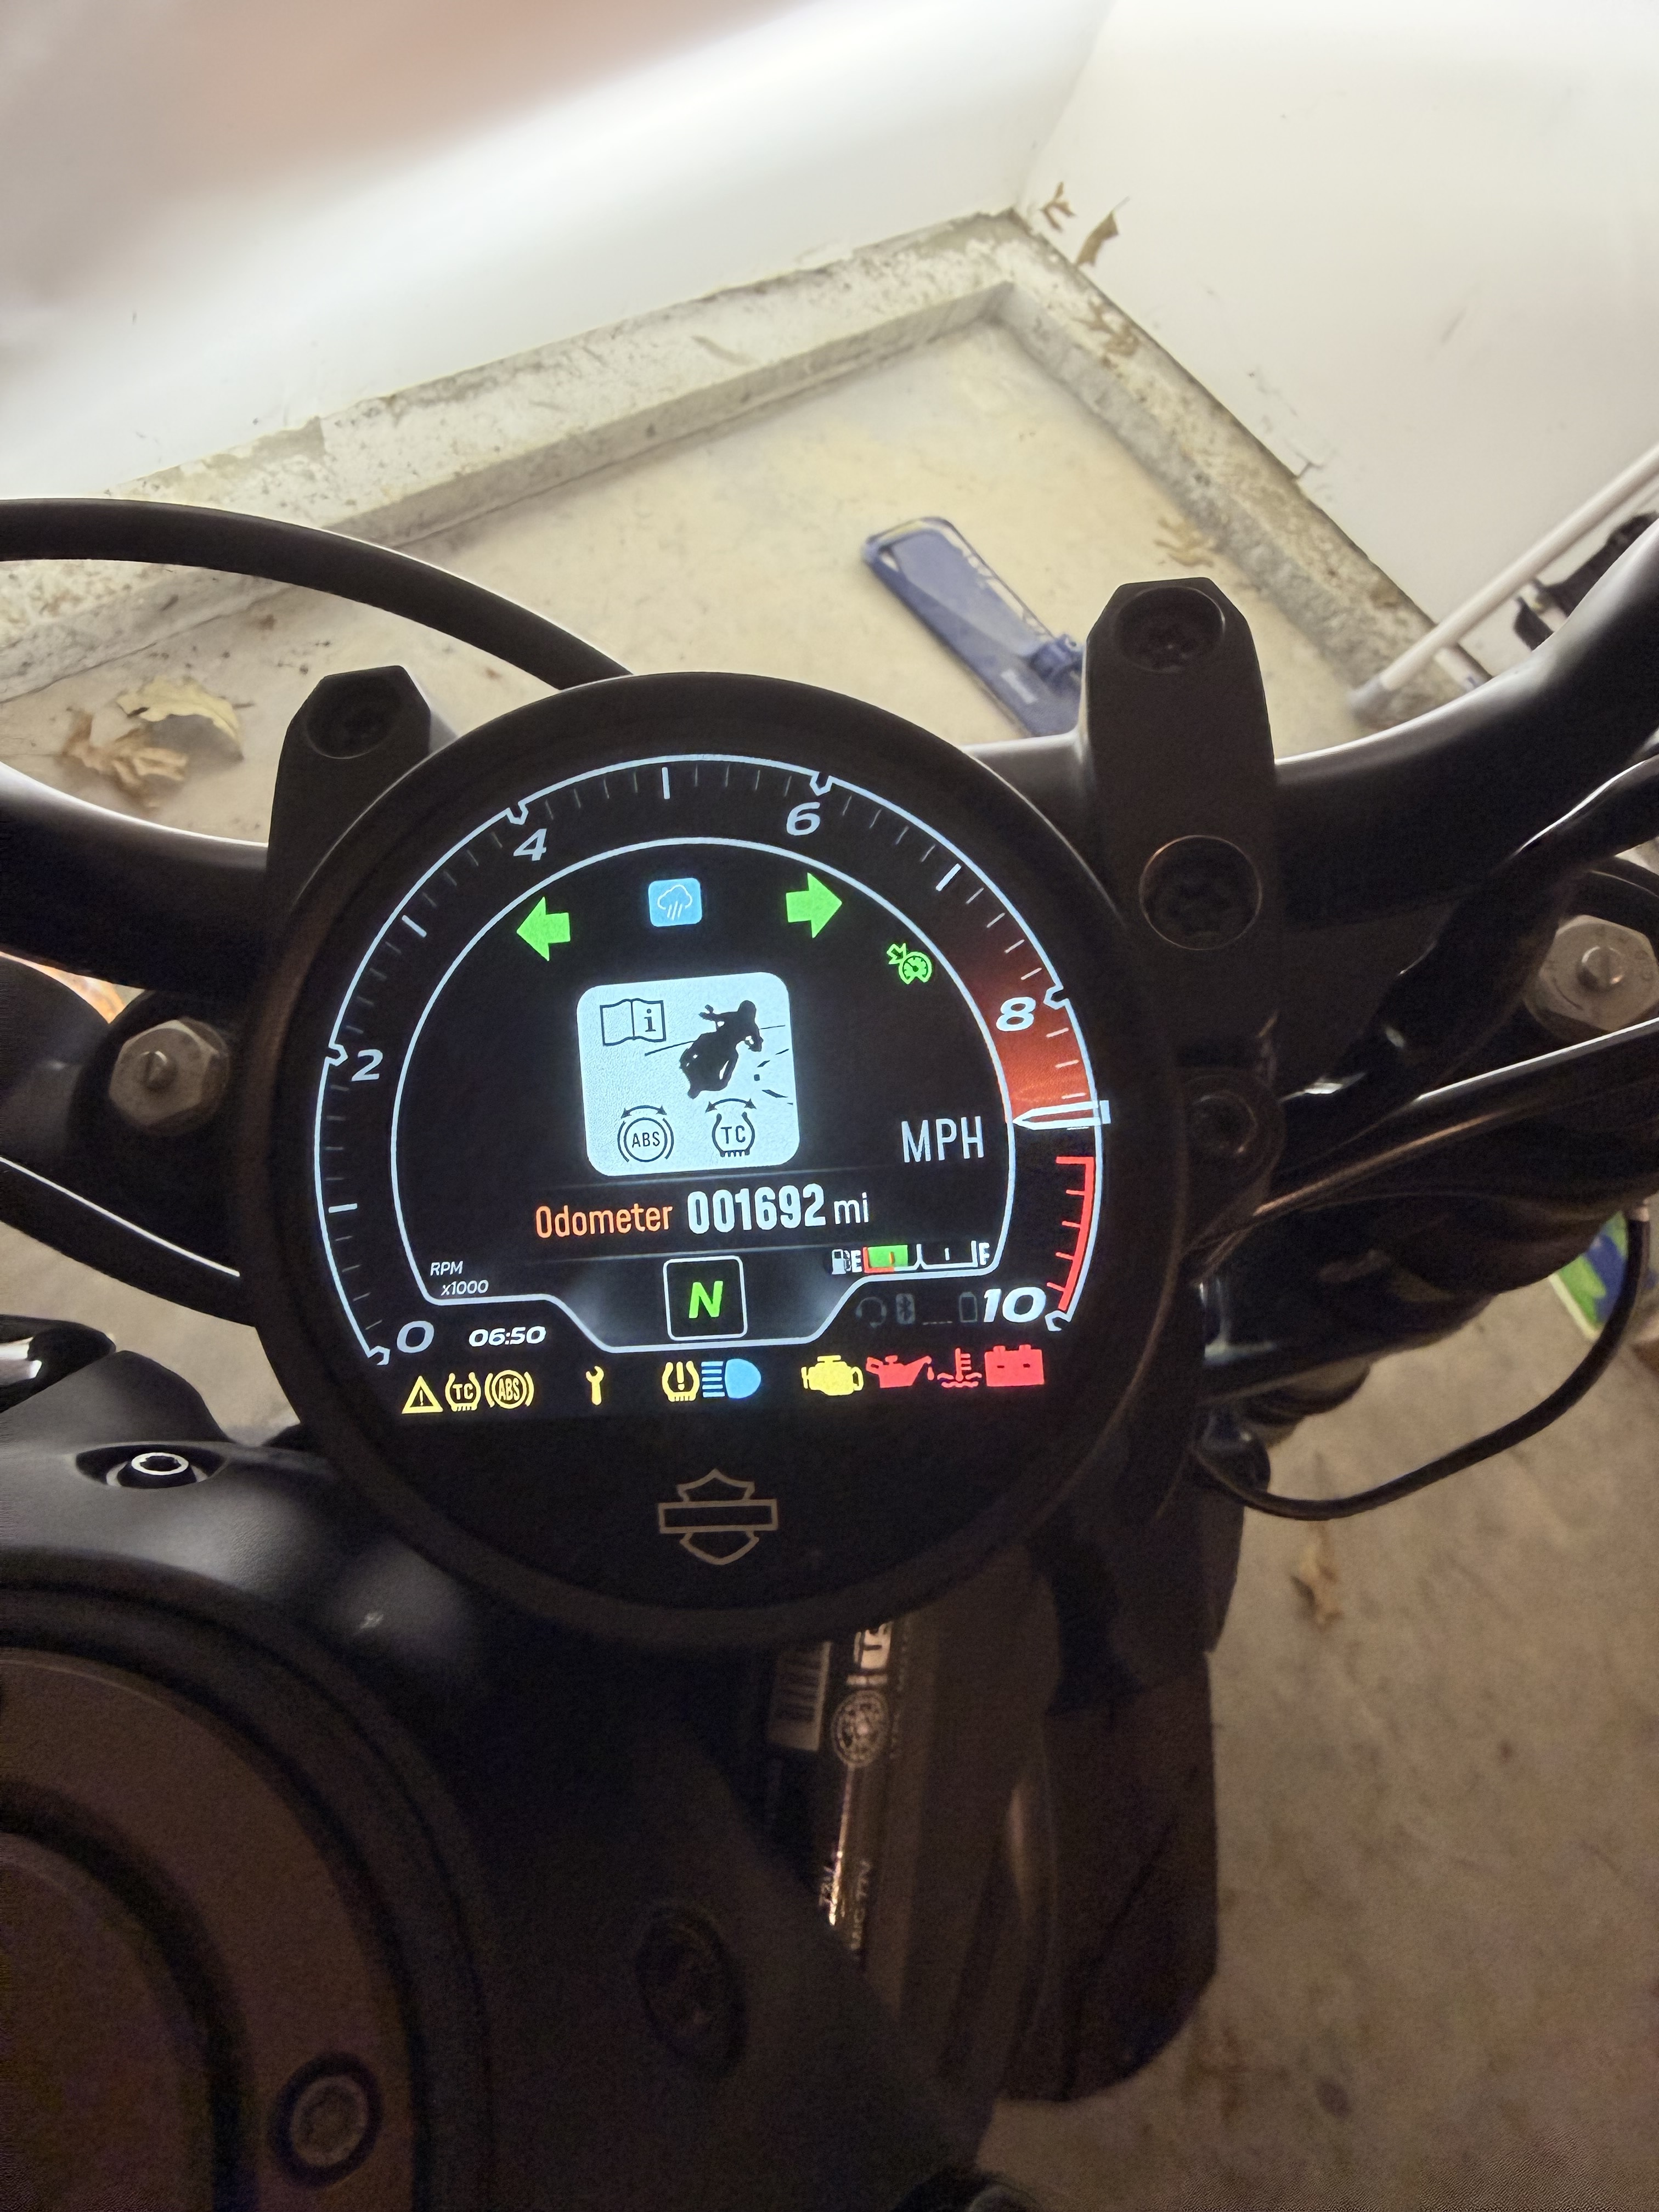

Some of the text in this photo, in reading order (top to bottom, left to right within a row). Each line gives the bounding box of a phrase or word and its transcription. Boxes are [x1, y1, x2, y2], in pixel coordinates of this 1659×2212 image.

[787, 802, 821, 836] 6
[514, 829, 546, 861] 4
[996, 997, 1036, 1031] 8
[352, 1049, 383, 1081] 2
[632, 1131, 661, 1148] ABS
[720, 1125, 746, 1144] TC
[901, 1115, 984, 1163] MPH
[535, 1183, 869, 1238] Odometer 001692 mi
[430, 1261, 464, 1276] RPM
[850, 1250, 862, 1273] E
[978, 1242, 990, 1266] F
[689, 1280, 724, 1319] N
[983, 1286, 1047, 1323] 10
[396, 1321, 435, 1353] 0
[469, 1325, 546, 1347] 06:50
[452, 1383, 474, 1401] TC
[498, 1377, 520, 1401] ABS
